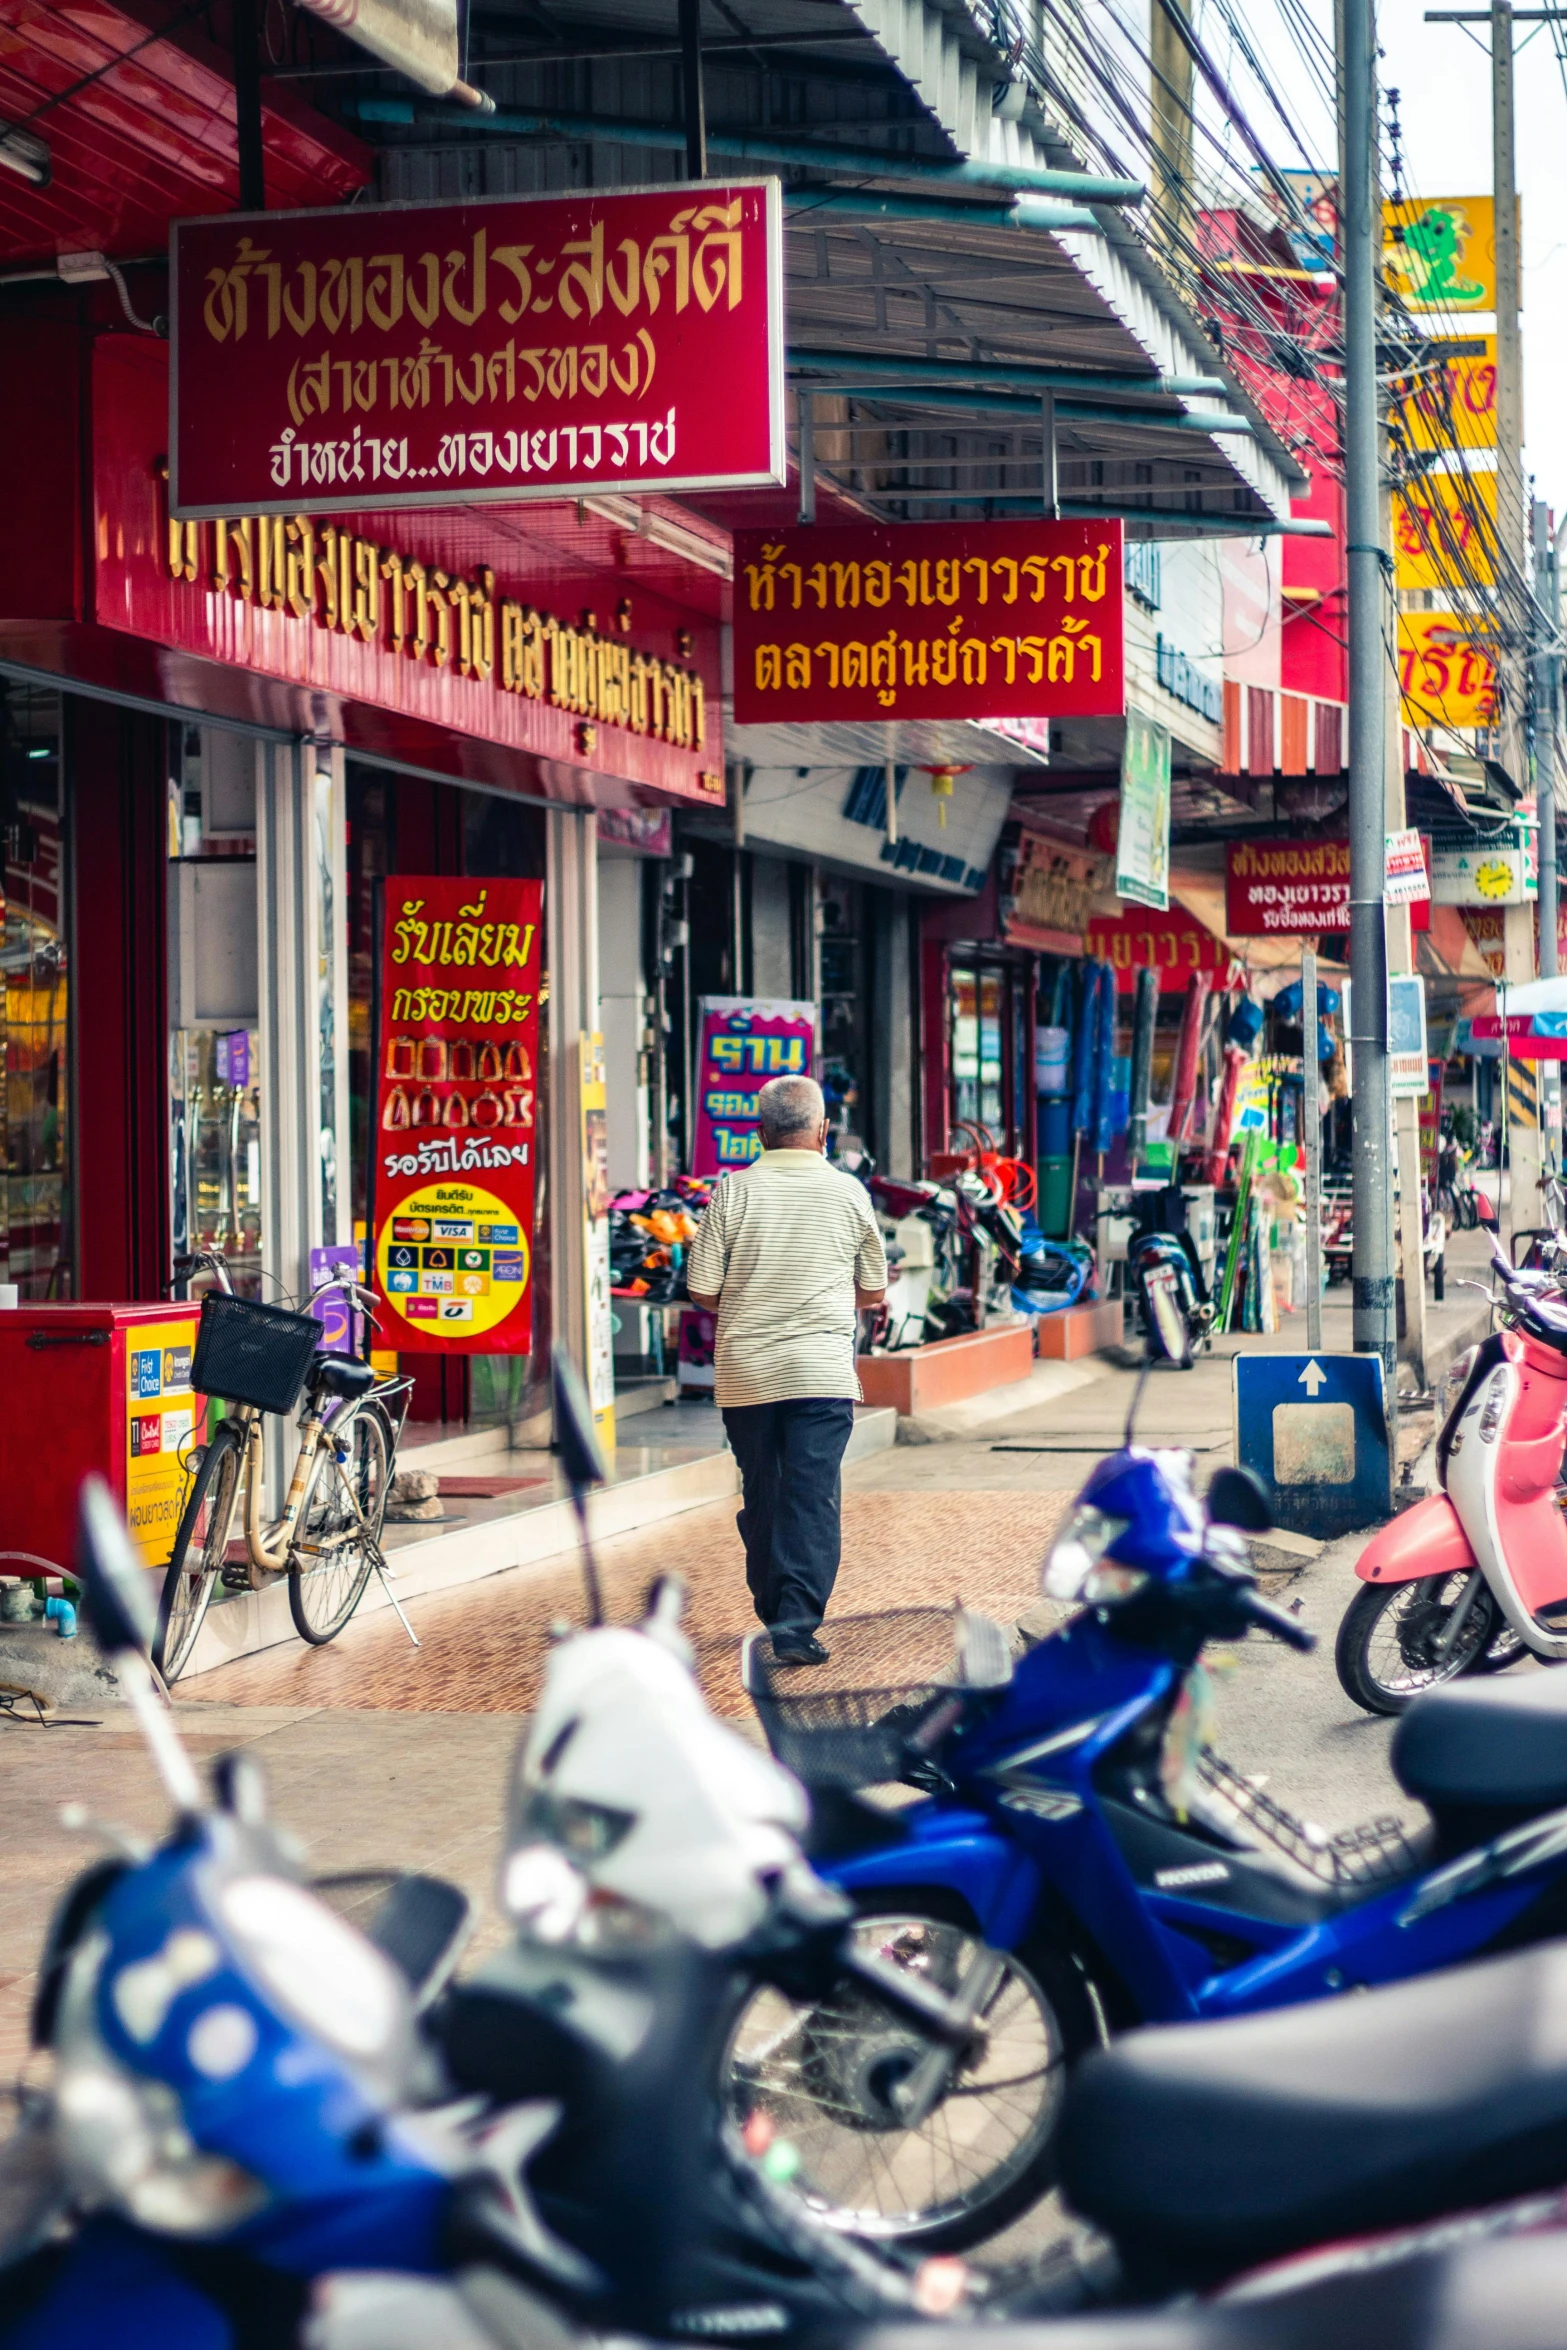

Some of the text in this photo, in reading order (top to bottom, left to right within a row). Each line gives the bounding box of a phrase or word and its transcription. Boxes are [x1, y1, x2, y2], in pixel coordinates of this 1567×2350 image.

[203, 197, 743, 342] ห้างทองประสงค์ดี
[287, 327, 656, 425] (สาขาห้างศรทอง)
[269, 407, 676, 486] จำหน่าย...ทองเยาวราช
[743, 543, 1109, 610] ห้างทองเยาวราช
[755, 615, 1102, 707] ตลาดศูนย์การค้า
[1248, 884, 1350, 904] ทองเยาวรา
[391, 889, 536, 968] รับเลี่ยม
[391, 987, 532, 1024] กรอบพระ
[711, 1018, 805, 1073] ร้าน
[384, 1136, 529, 1178] รอรับได้เลย
[440, 1226, 467, 1237] VISA
[494, 1234, 517, 1242] Choice
[424, 1276, 452, 1291] TMB
[140, 1375, 160, 1393] Choice
[141, 1356, 154, 1375] First
[1155, 1861, 1229, 1888] HONDA
